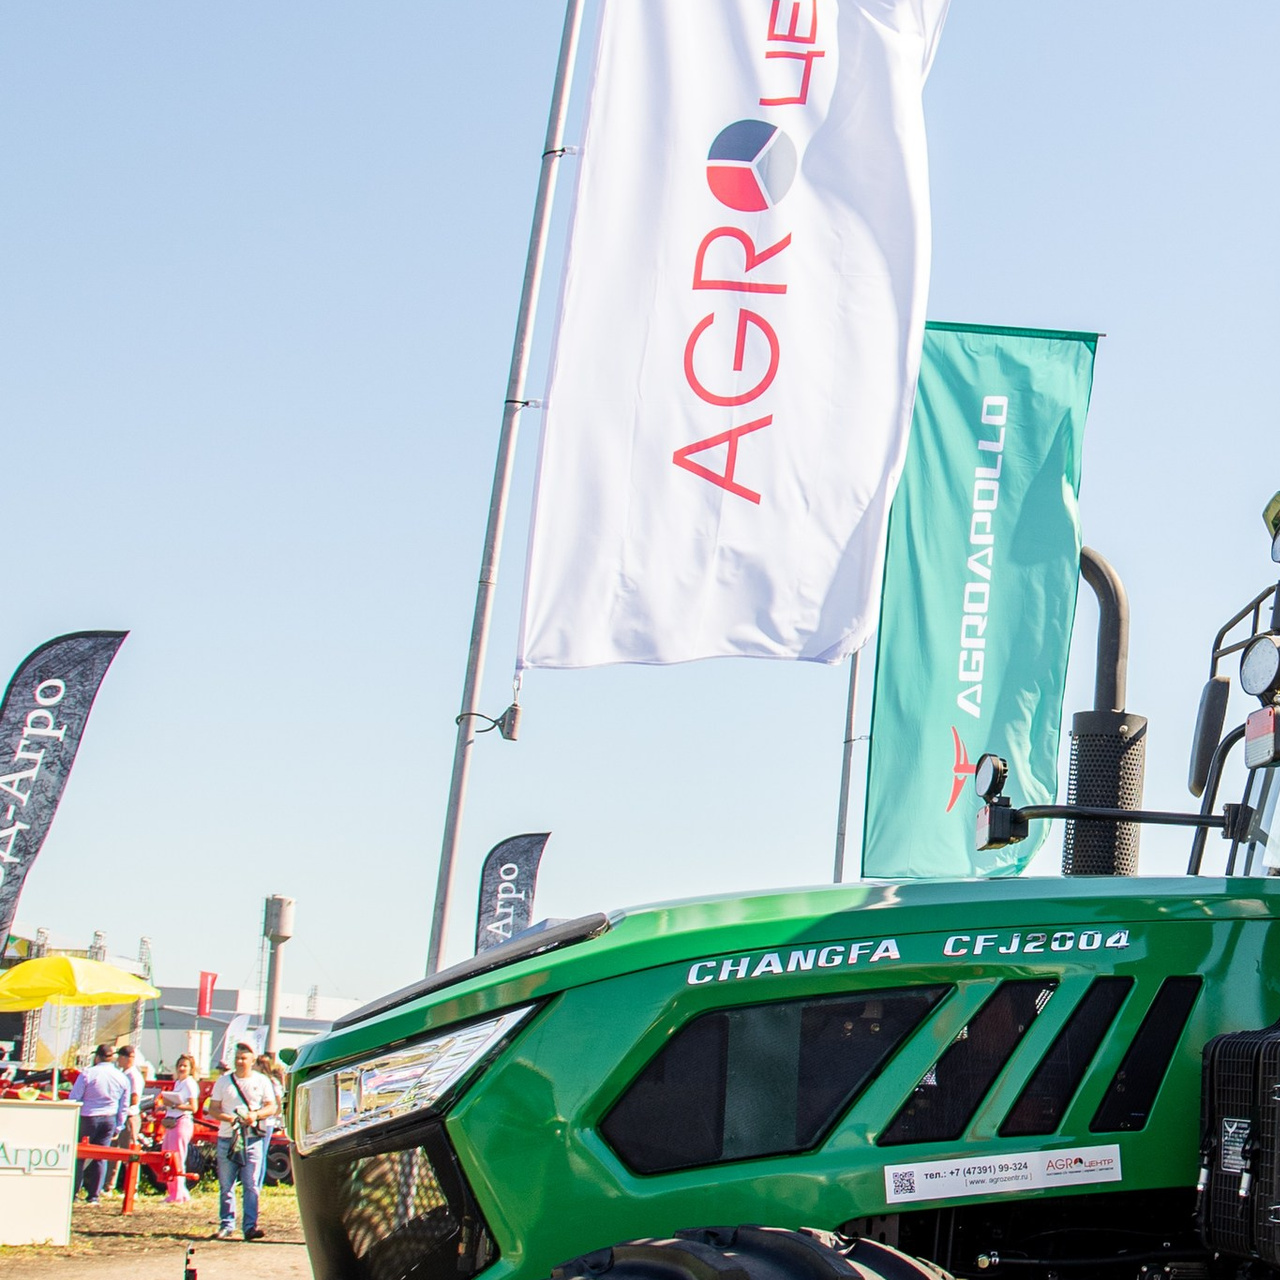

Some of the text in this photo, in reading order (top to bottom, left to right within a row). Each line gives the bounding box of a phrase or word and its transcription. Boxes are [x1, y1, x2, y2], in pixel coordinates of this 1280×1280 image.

[956, 395, 1010, 718] AGROAPOLLO
[686, 929, 1131, 986] CHANGFA CFJ2004
[949, 1167, 961, 1177] +7
[962, 1164, 996, 1178] (47391)
[998, 1161, 1029, 1172] 99-324
